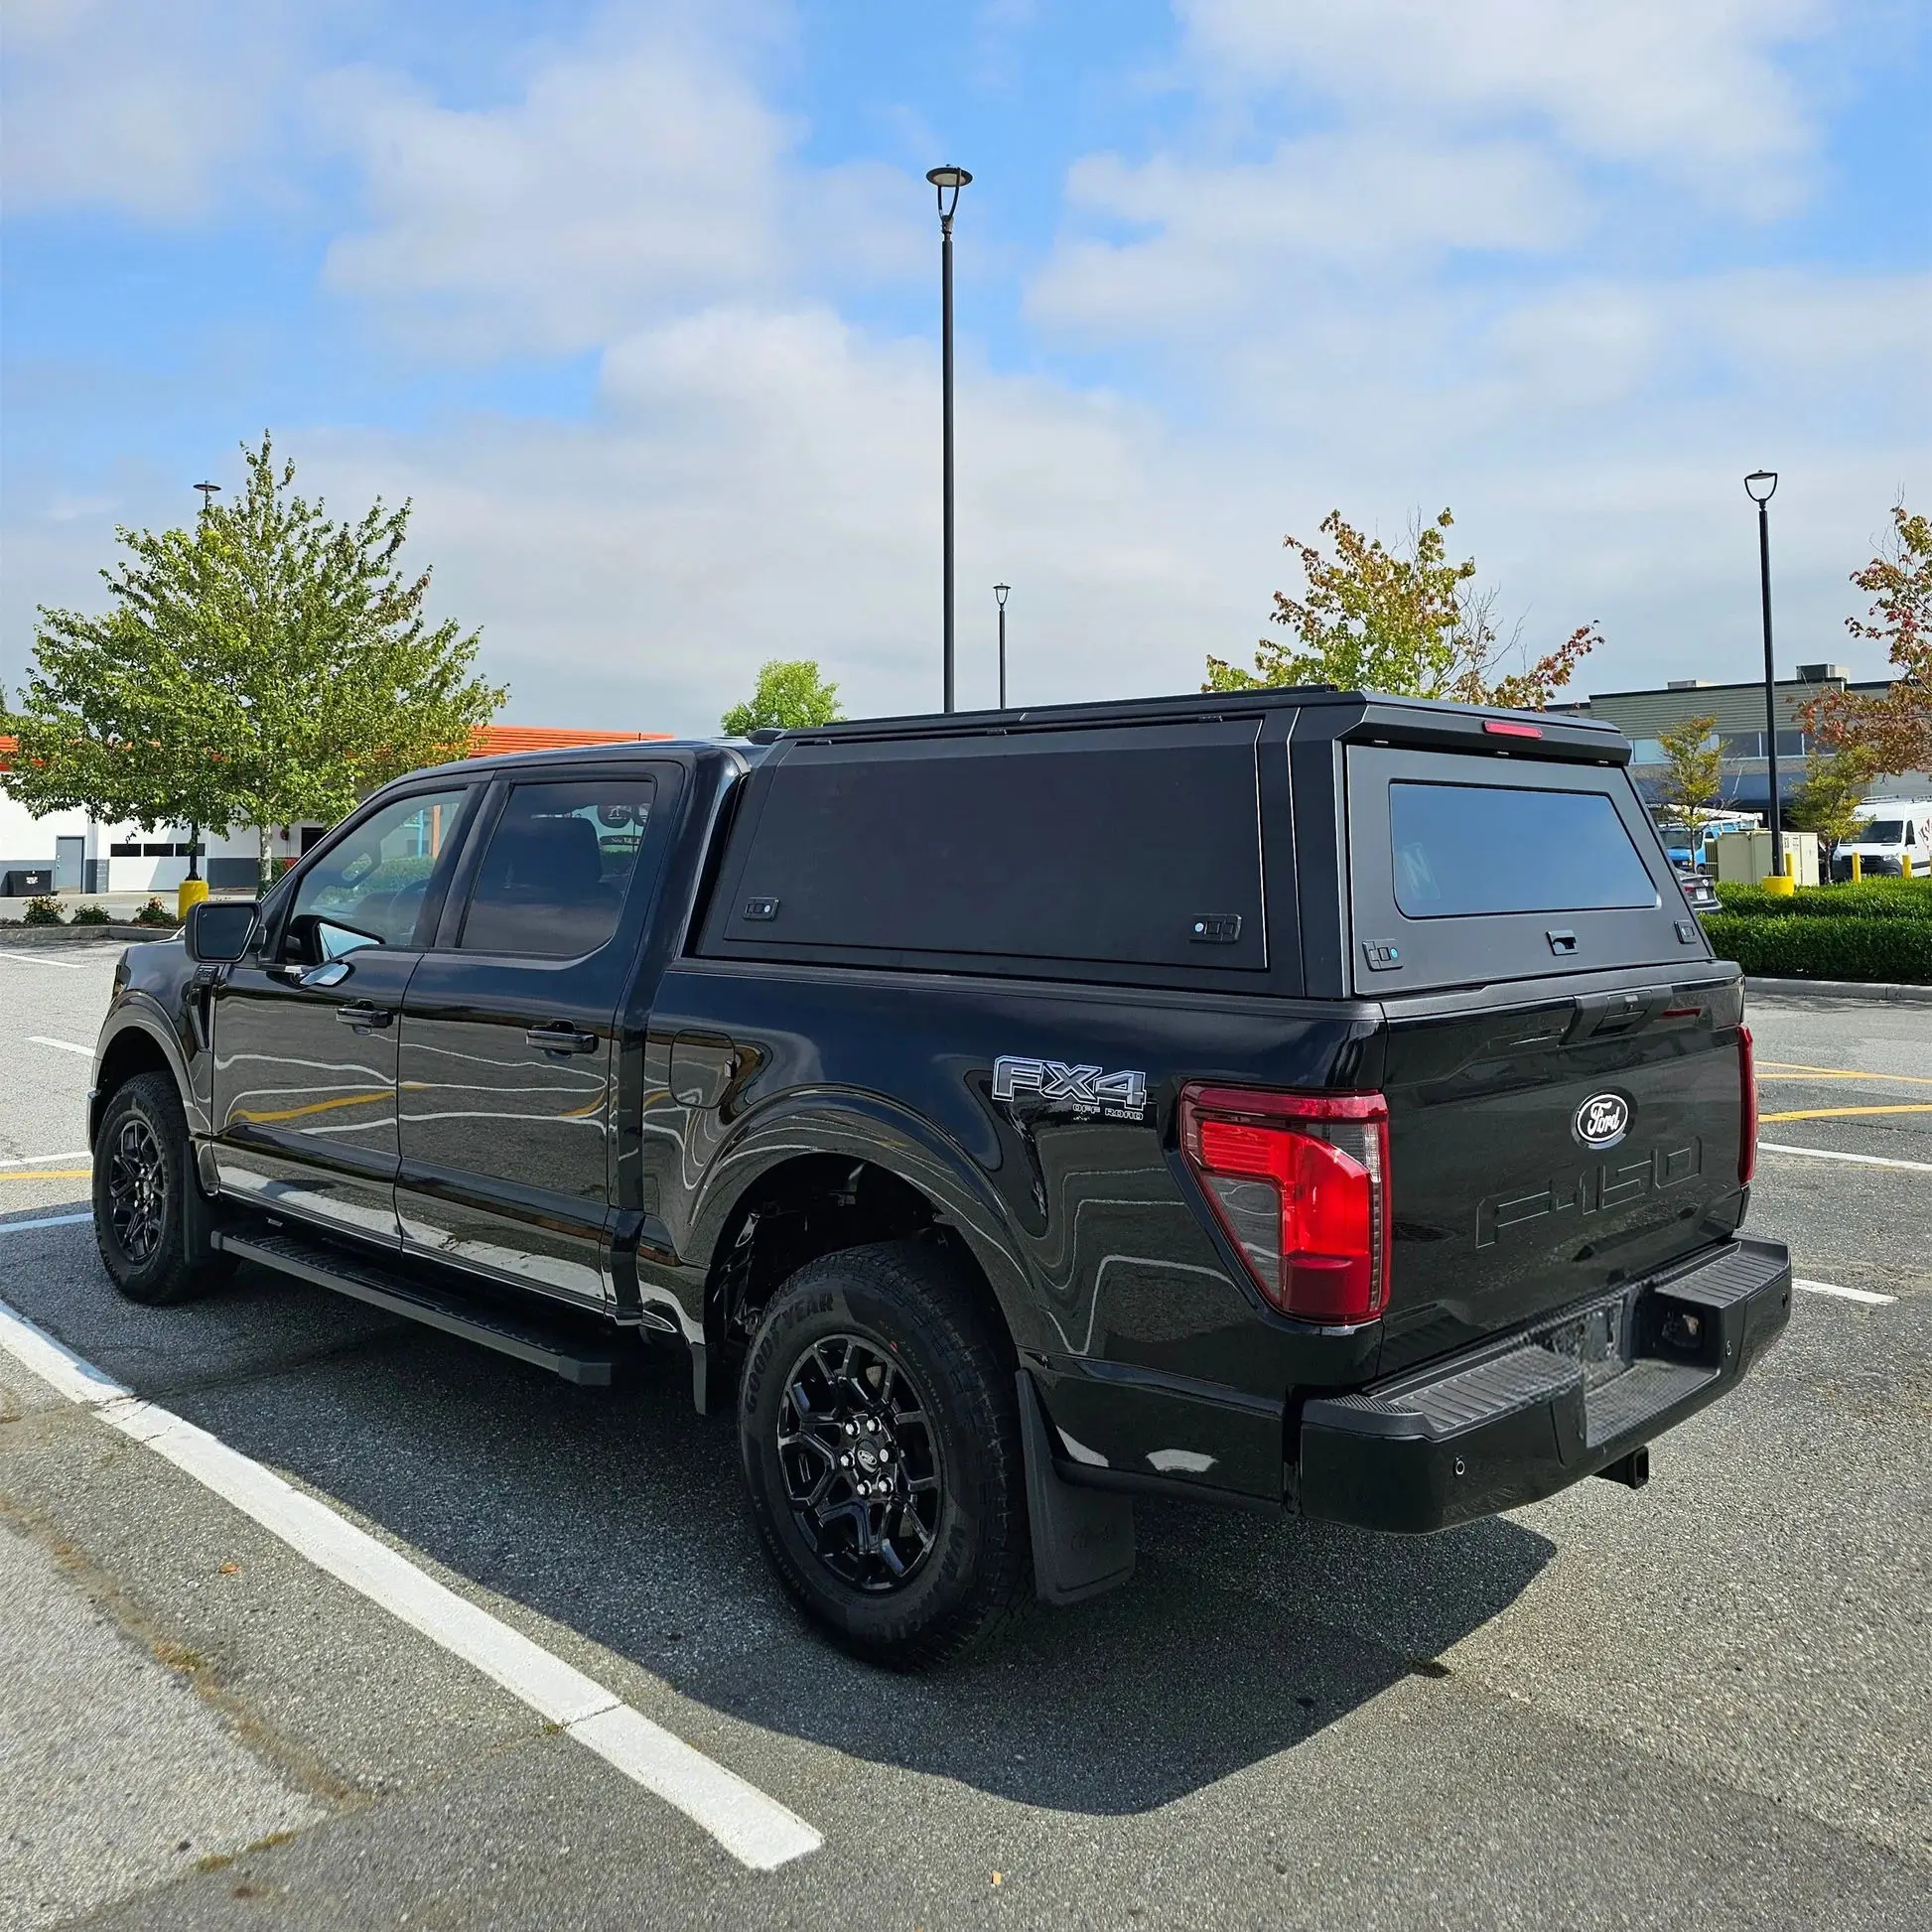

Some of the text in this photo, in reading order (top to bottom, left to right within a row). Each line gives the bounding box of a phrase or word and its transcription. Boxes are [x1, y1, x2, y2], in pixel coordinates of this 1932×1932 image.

[992, 1055, 1147, 1111] FX4
[1072, 1102, 1144, 1122] OFF ROAD
[1587, 1100, 1621, 1137] Ford
